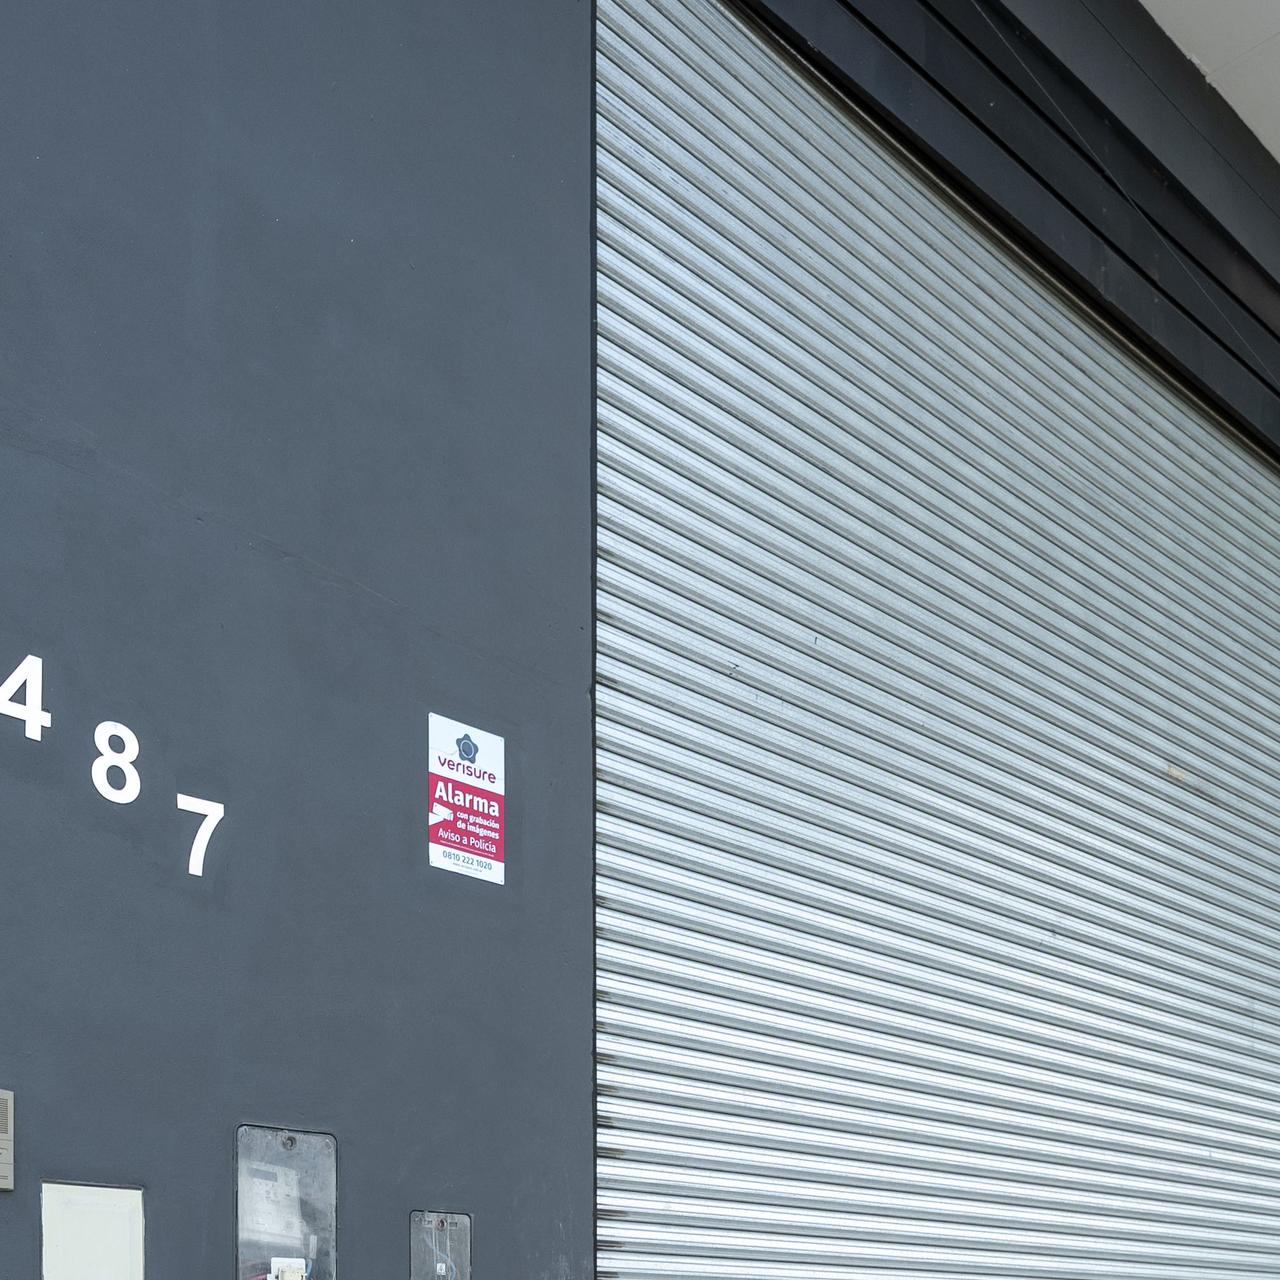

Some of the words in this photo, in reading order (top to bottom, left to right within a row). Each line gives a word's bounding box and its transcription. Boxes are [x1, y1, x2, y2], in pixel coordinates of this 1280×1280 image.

[437, 755, 496, 784] verisure
[434, 780, 500, 817] Alarma
[456, 811, 468, 820] con
[456, 820, 466, 830] de
[438, 828, 461, 842] Aviso
[462, 836, 468, 845] a
[442, 850, 461, 862] 0810
[462, 855, 475, 866] 222
[476, 859, 493, 871] 1020
